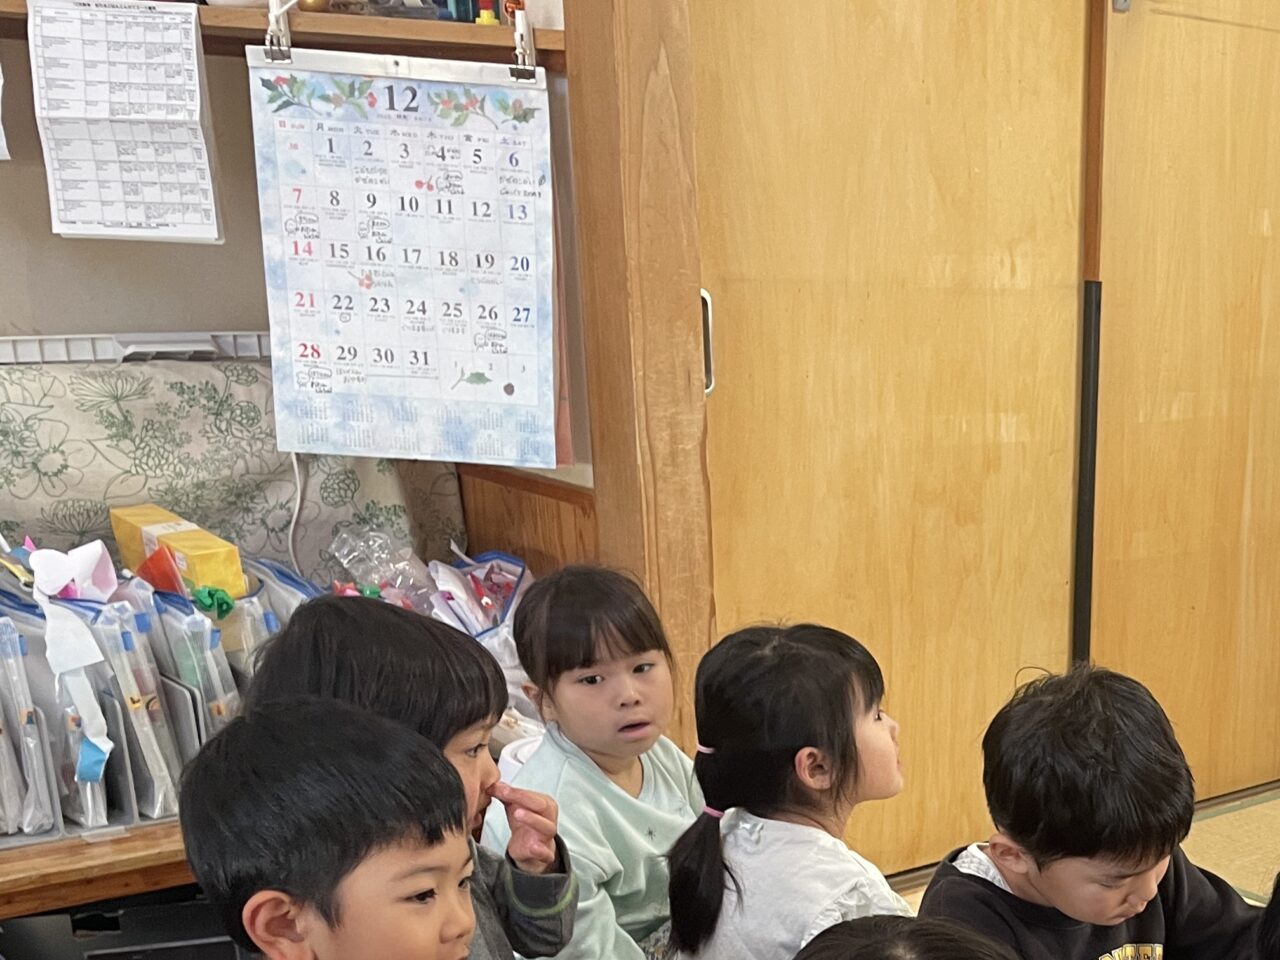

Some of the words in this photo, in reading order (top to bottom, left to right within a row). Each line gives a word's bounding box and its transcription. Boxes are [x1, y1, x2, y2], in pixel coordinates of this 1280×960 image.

[384, 85, 420, 112] 12
[327, 138, 336, 154] 1
[363, 140, 373, 156] 2
[399, 143, 409, 159] 3
[435, 145, 446, 161] 4
[473, 148, 482, 164] 5
[509, 152, 519, 168] 6
[292, 188, 302, 203] 7
[330, 190, 340, 206] 8
[366, 193, 376, 209] 9
[400, 196, 419, 212] 10
[437, 199, 454, 215] 11
[472, 201, 491, 217] 12
[508, 204, 528, 220] 13
[293, 240, 313, 256] 14
[330, 243, 349, 259] 15
[366, 246, 386, 262] 16
[403, 248, 421, 264] 17
[439, 251, 459, 267] 18
[475, 253, 495, 269] 19
[510, 256, 530, 272] 20
[295, 292, 315, 308] 21
[332, 294, 354, 310] 22
[369, 297, 390, 313] 23
[406, 299, 427, 316] 24
[442, 302, 463, 318] 25
[477, 304, 498, 320] 26
[512, 307, 531, 323] 27
[298, 343, 321, 359] 28
[336, 345, 357, 361] 29
[372, 347, 394, 364] 30
[409, 350, 429, 366] 31
